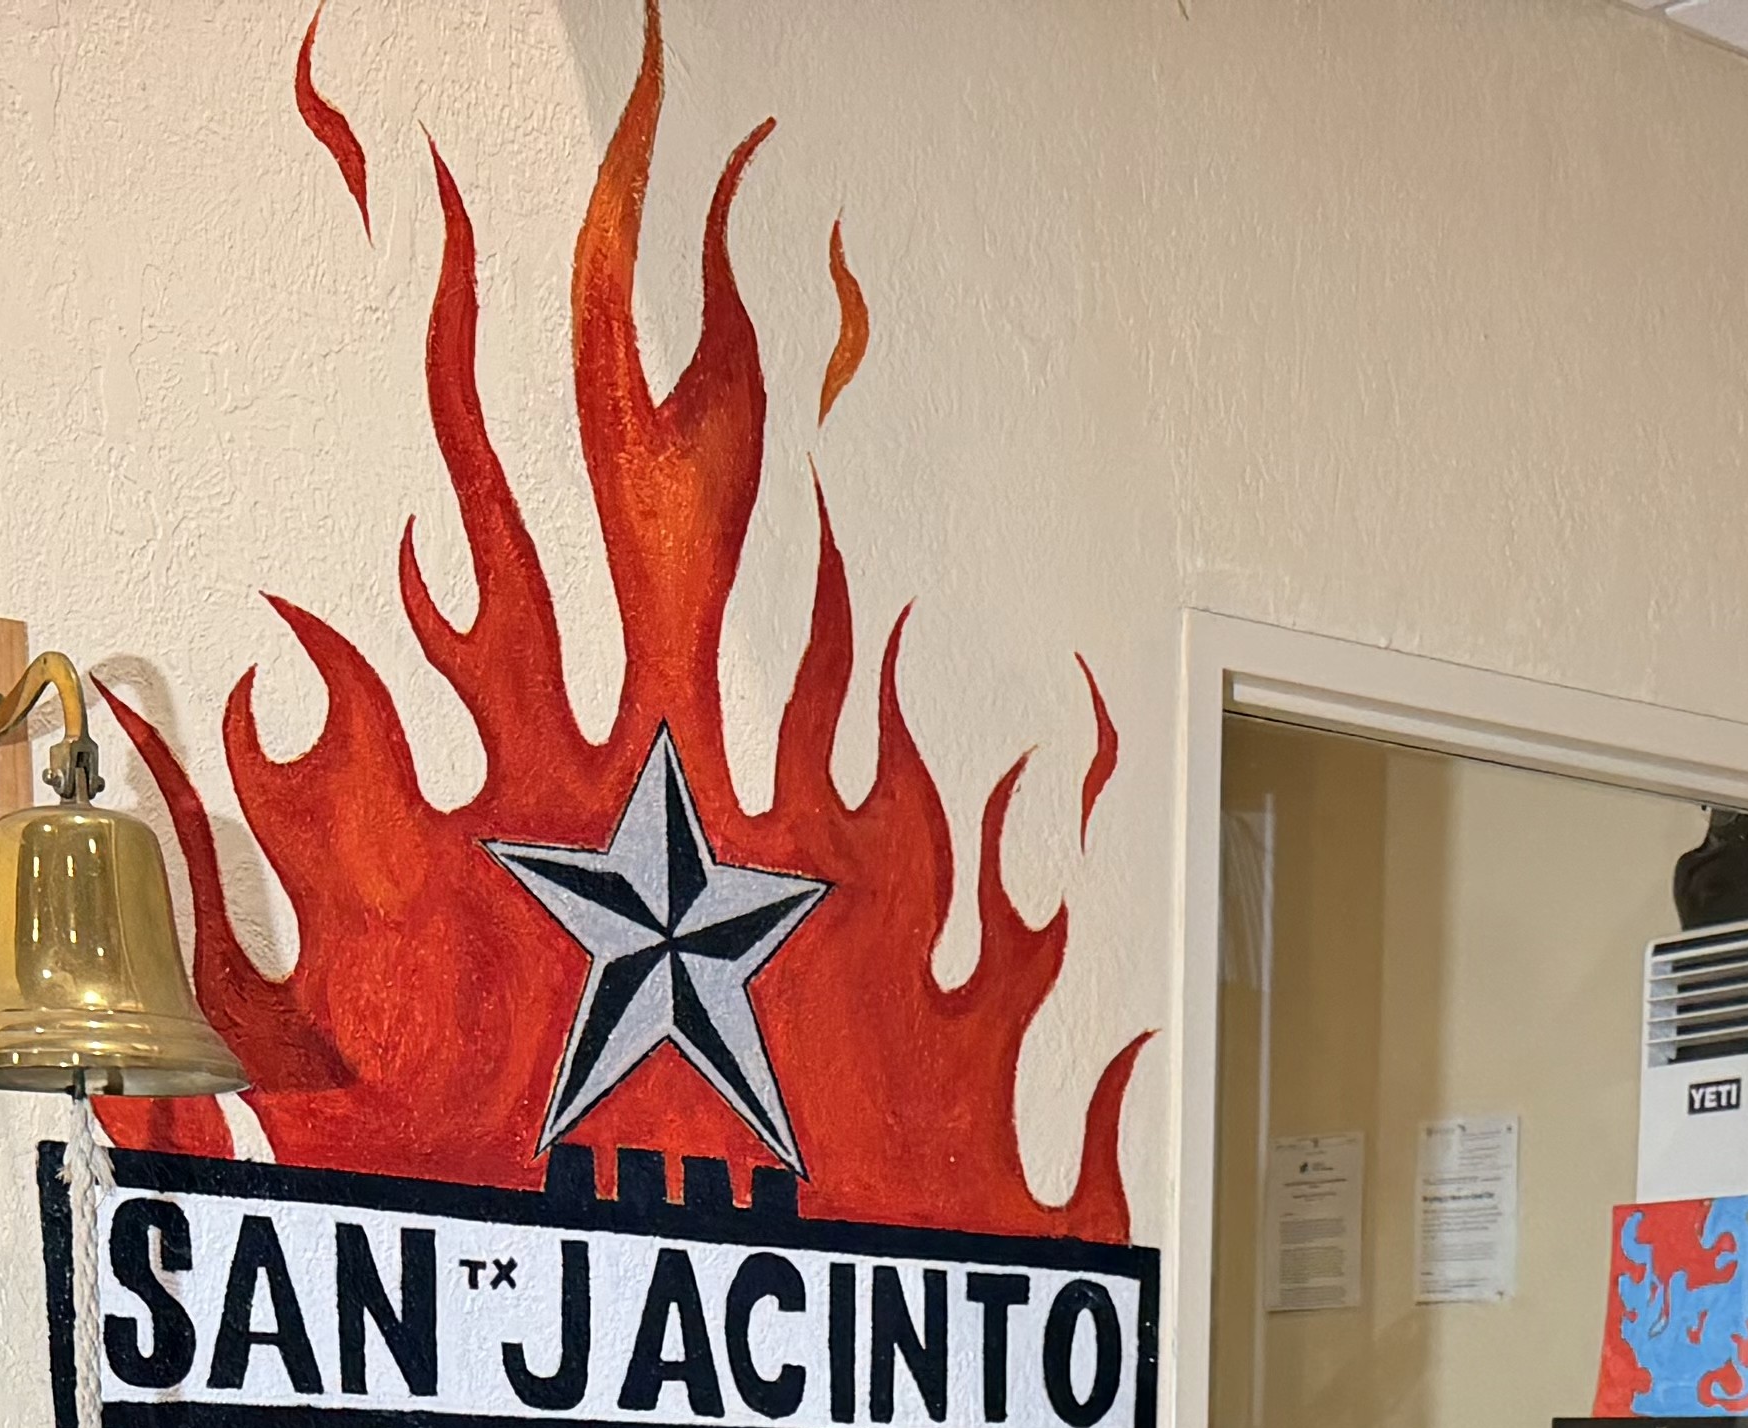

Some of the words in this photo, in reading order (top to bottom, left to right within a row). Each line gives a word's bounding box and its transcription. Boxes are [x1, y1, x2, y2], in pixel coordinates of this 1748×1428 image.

[1690, 1083, 1738, 1110] YETI
[104, 1196, 440, 1399] SAN
[458, 1256, 519, 1291] TX
[501, 1238, 1122, 1427] JACINTO
